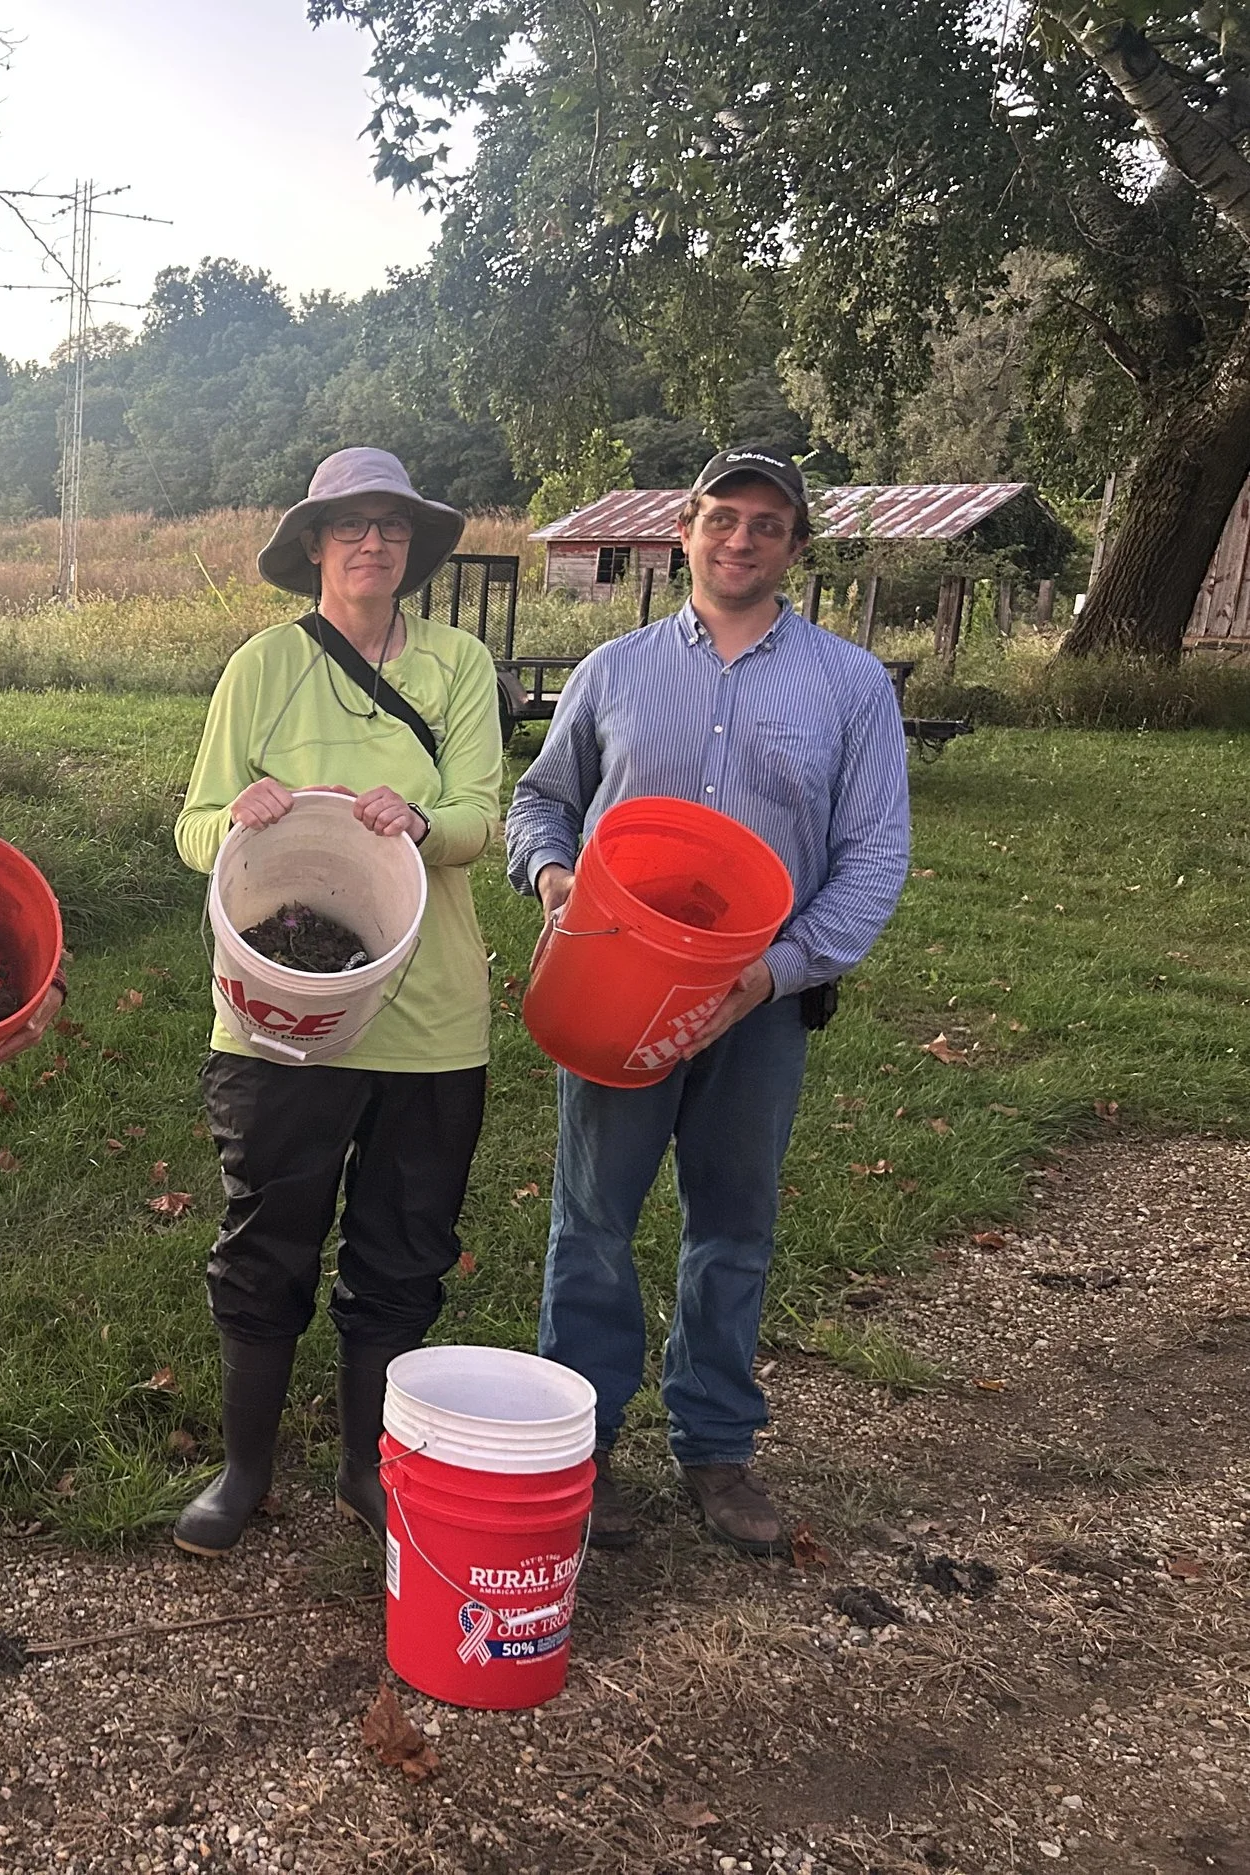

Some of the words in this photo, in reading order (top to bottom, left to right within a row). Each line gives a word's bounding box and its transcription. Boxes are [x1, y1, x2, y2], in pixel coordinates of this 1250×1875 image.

[469, 1566, 549, 1588] RURAL
[553, 1548, 580, 1582] KIN
[479, 1587, 522, 1595] AMERICA'S
[523, 1586, 543, 1595] FARM
[497, 1621, 536, 1637] OUR
[502, 1641, 535, 1656] 50%
